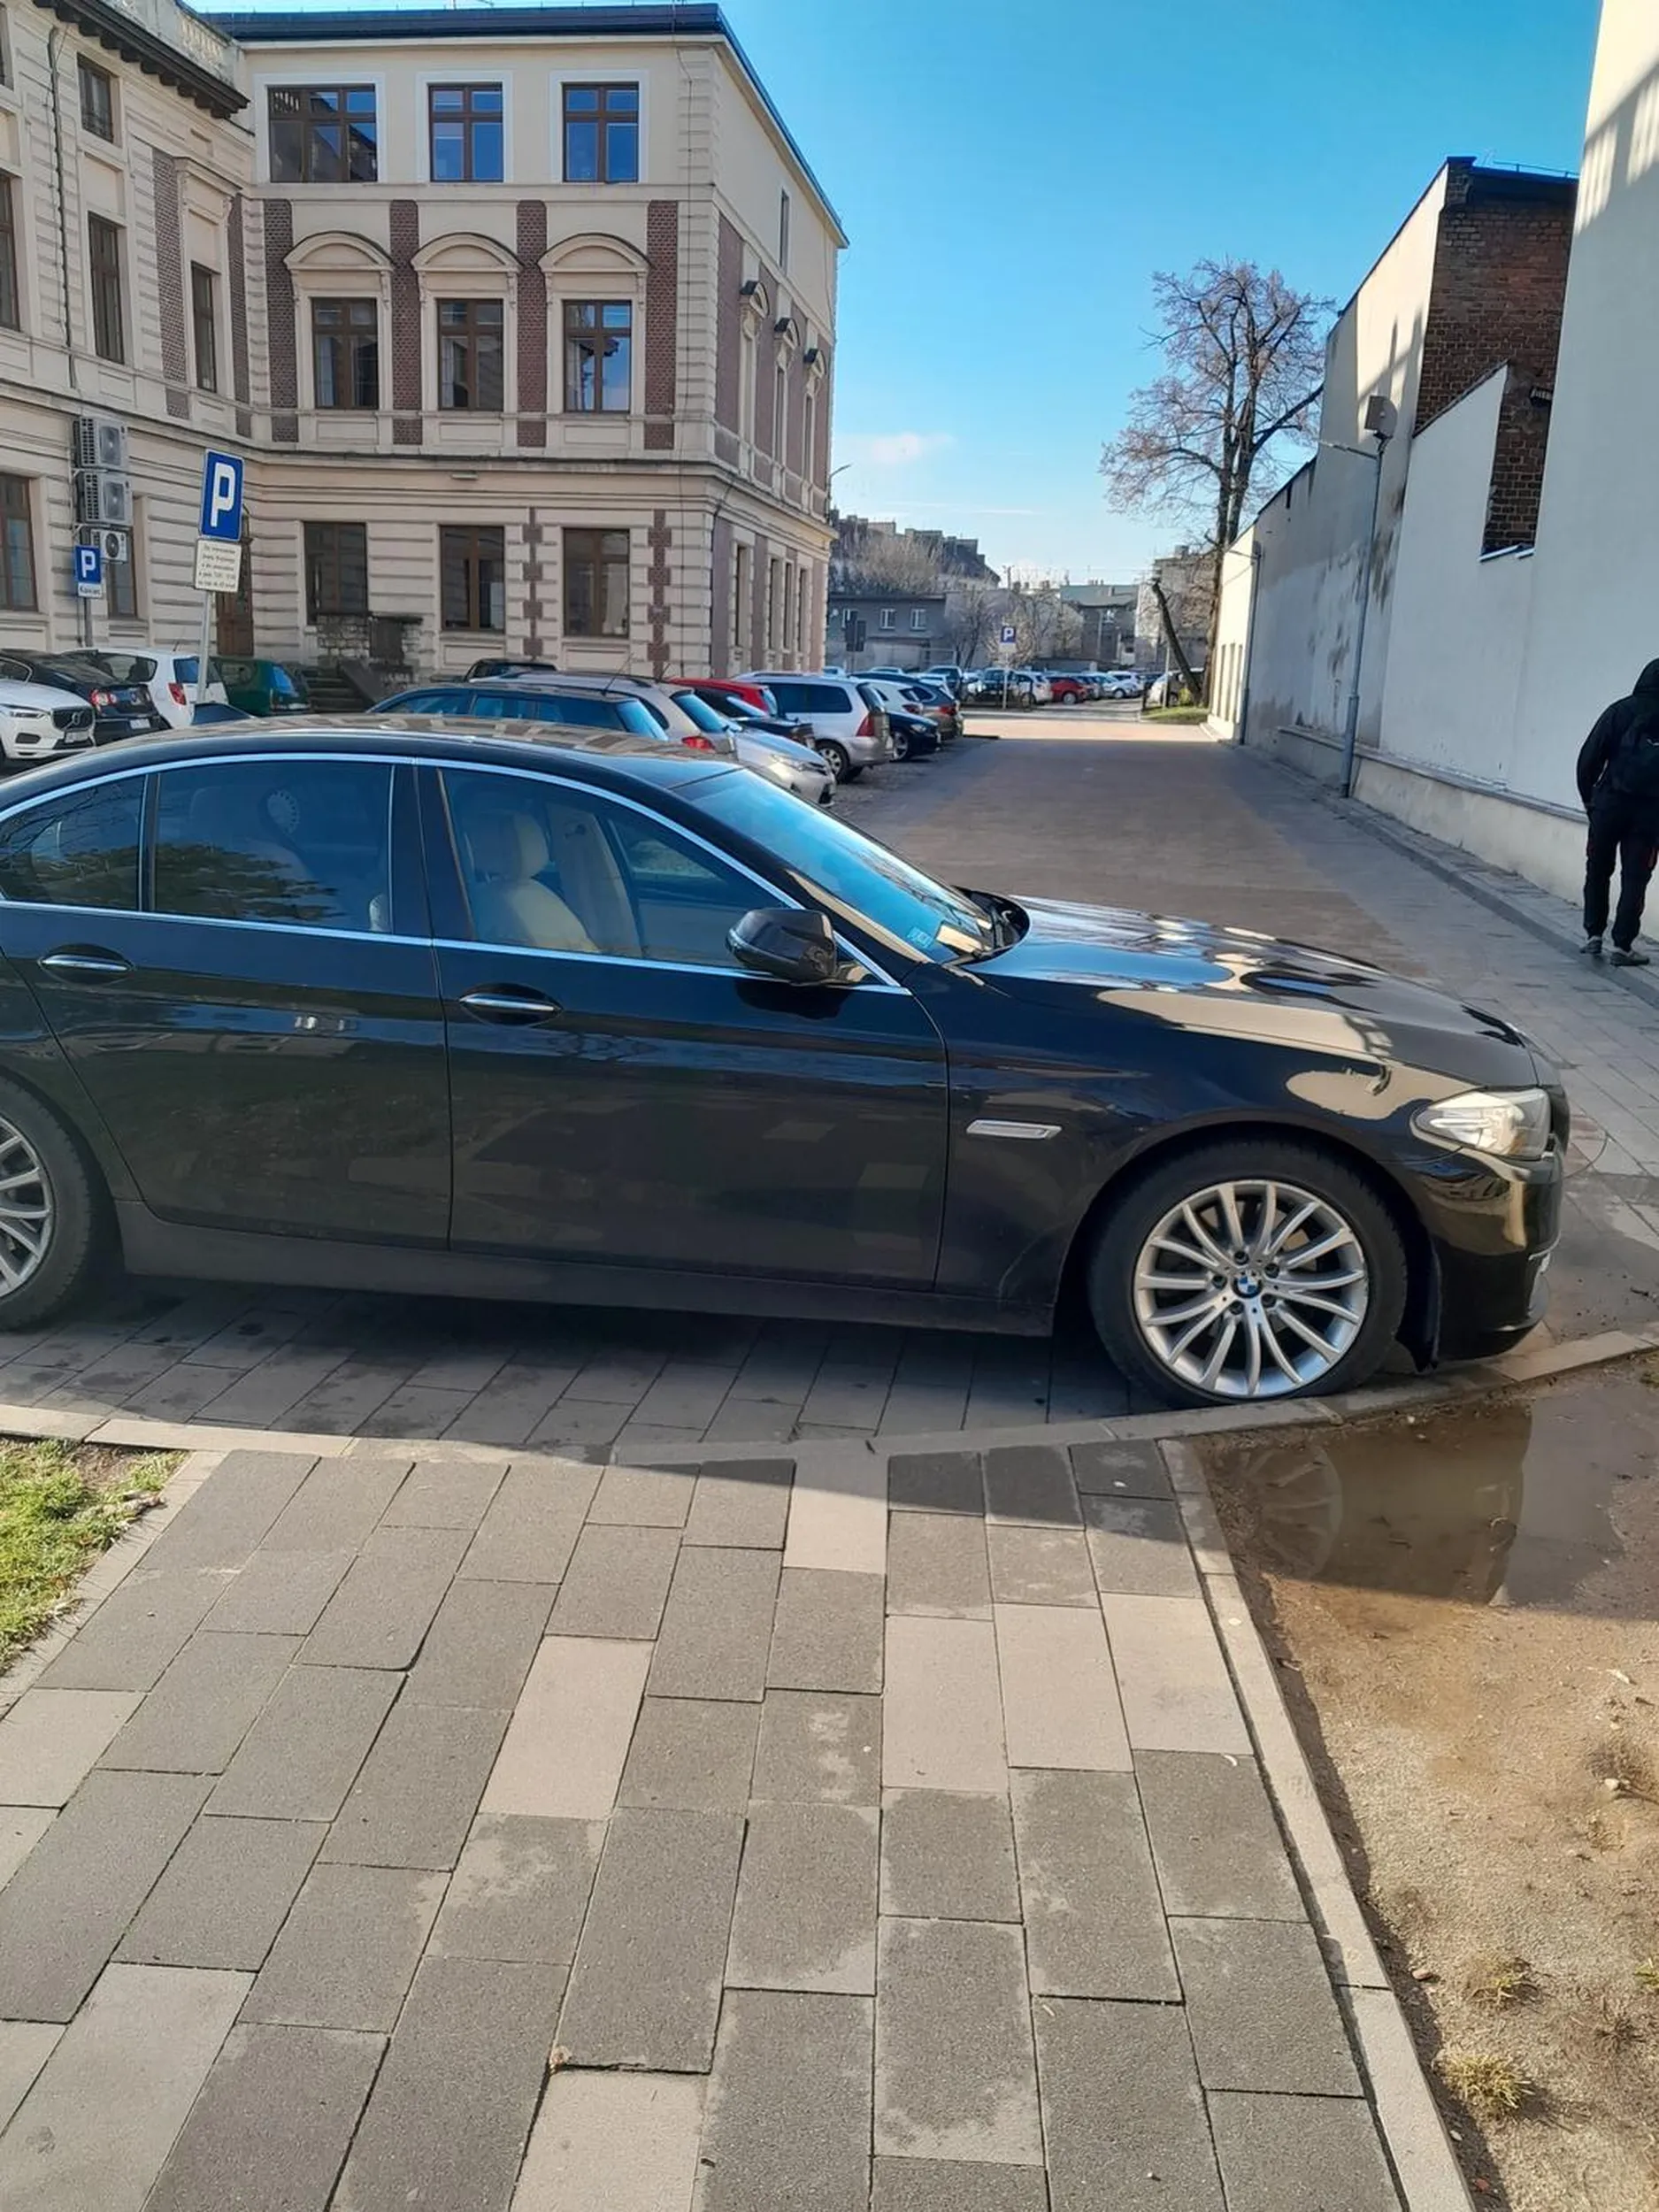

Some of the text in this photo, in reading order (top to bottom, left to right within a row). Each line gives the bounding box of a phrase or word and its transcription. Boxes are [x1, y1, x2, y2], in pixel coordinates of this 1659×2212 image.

[211, 462, 236, 527] P
[81, 549, 96, 578] P
[1003, 627, 1015, 641] P
